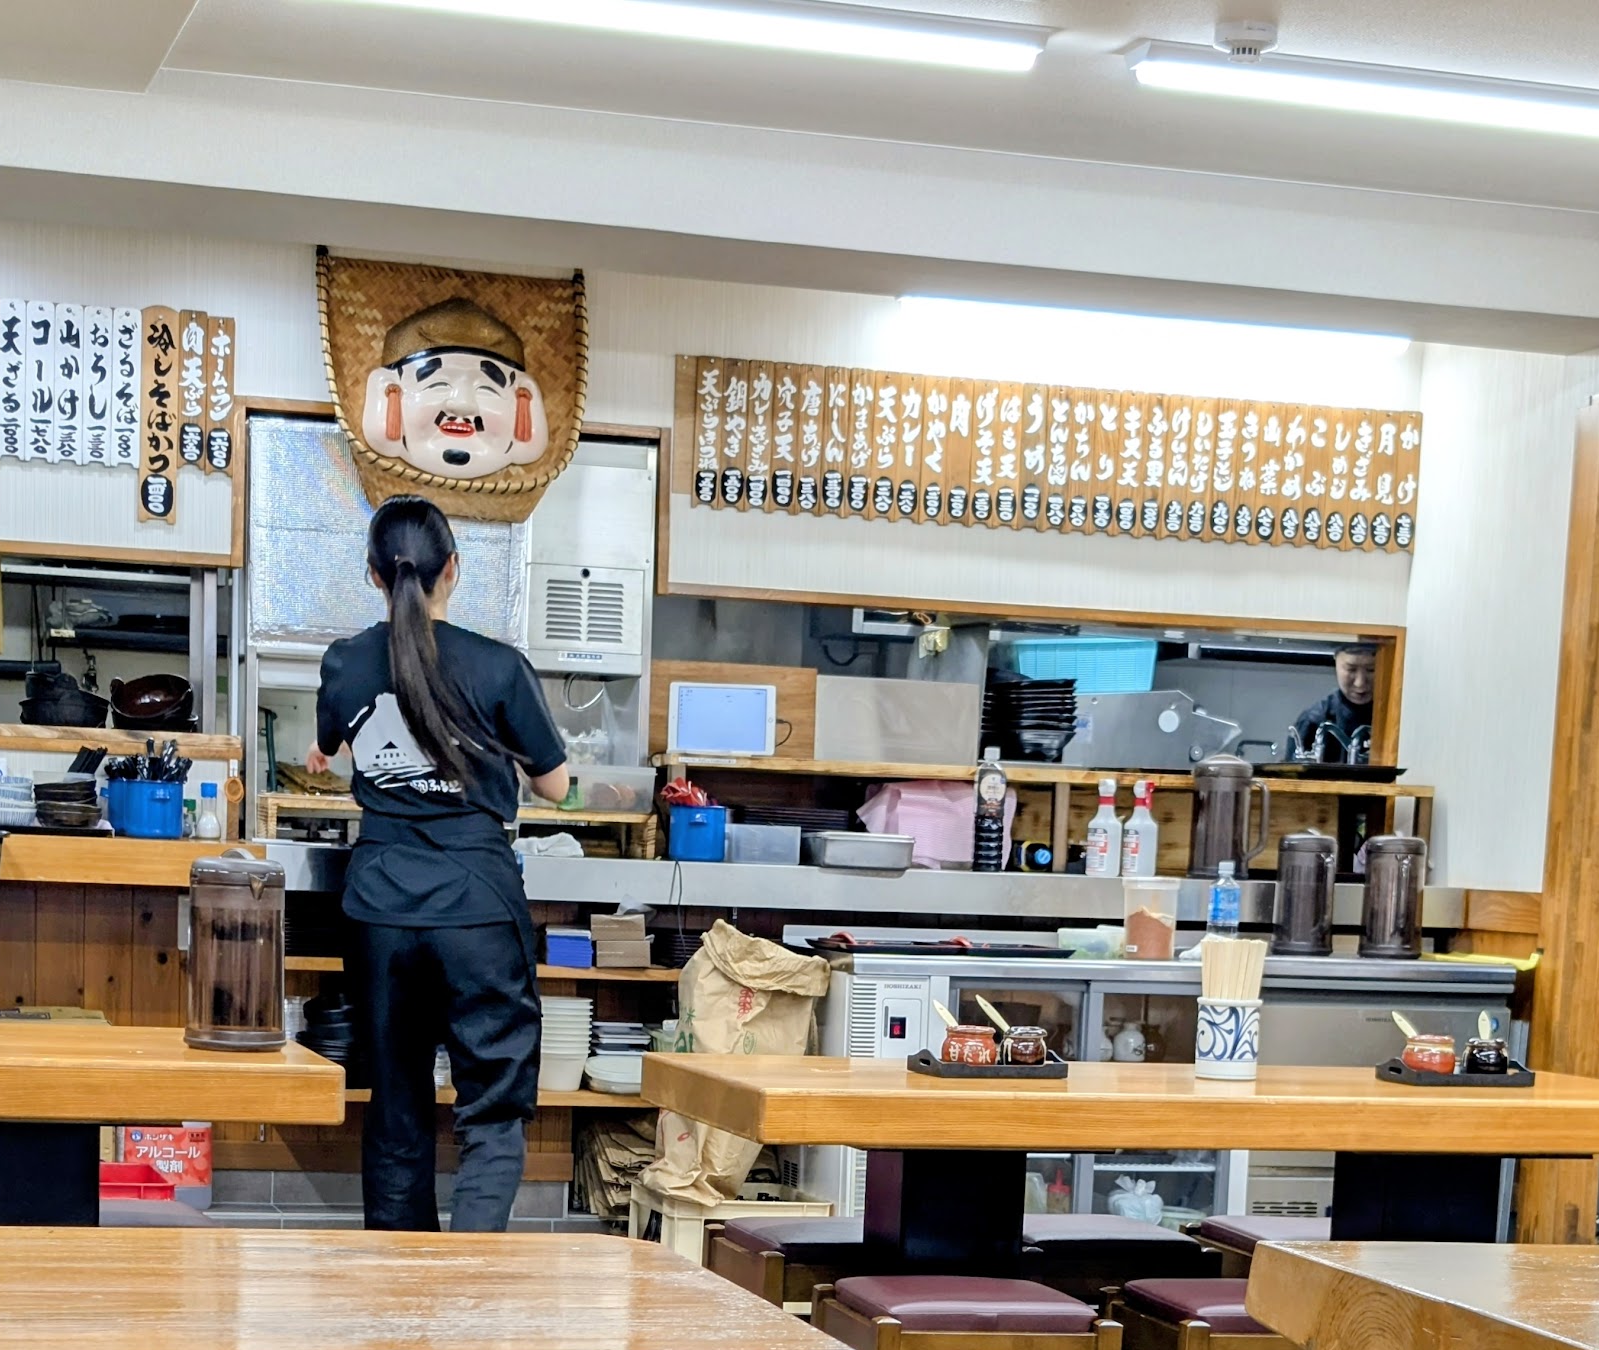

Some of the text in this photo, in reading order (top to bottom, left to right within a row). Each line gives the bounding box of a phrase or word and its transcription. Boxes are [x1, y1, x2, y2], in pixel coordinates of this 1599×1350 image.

[0, 315, 23, 414] 天ざる
[30, 319, 53, 414] コール
[58, 320, 81, 421] 山かけ
[88, 323, 109, 421] おろし
[115, 323, 140, 426] ざるそば
[147, 323, 177, 474] 冷しそばかつ
[178, 322, 207, 417] 肉天ぷら
[209, 330, 234, 422] ホームラン
[773, 377, 797, 462] 穴子天
[801, 381, 823, 467] 唐あげ
[825, 383, 847, 463] にしん
[851, 383, 874, 469] かまあげ
[876, 386, 898, 469] 天ぷら
[901, 387, 922, 467] カレー
[924, 389, 948, 474] かやく
[950, 393, 972, 437] 肉
[972, 388, 999, 486] げそ天
[996, 396, 1022, 480] はも天
[1024, 393, 1045, 476] うめ
[1070, 401, 1095, 482] かちん
[1096, 403, 1119, 481] とり
[1238, 411, 1259, 491] きつね
[1260, 415, 1281, 496] 山菜
[1281, 415, 1306, 500] わかめ
[1305, 418, 1327, 497] こぶ
[1330, 422, 1351, 500] しめじ
[1350, 421, 1373, 502] きざみ
[1374, 423, 1396, 505] 月見
[1397, 423, 1419, 505] かけ
[948, 1041, 992, 1064] 甘だれ
[135, 1145, 201, 1159] アルコール
